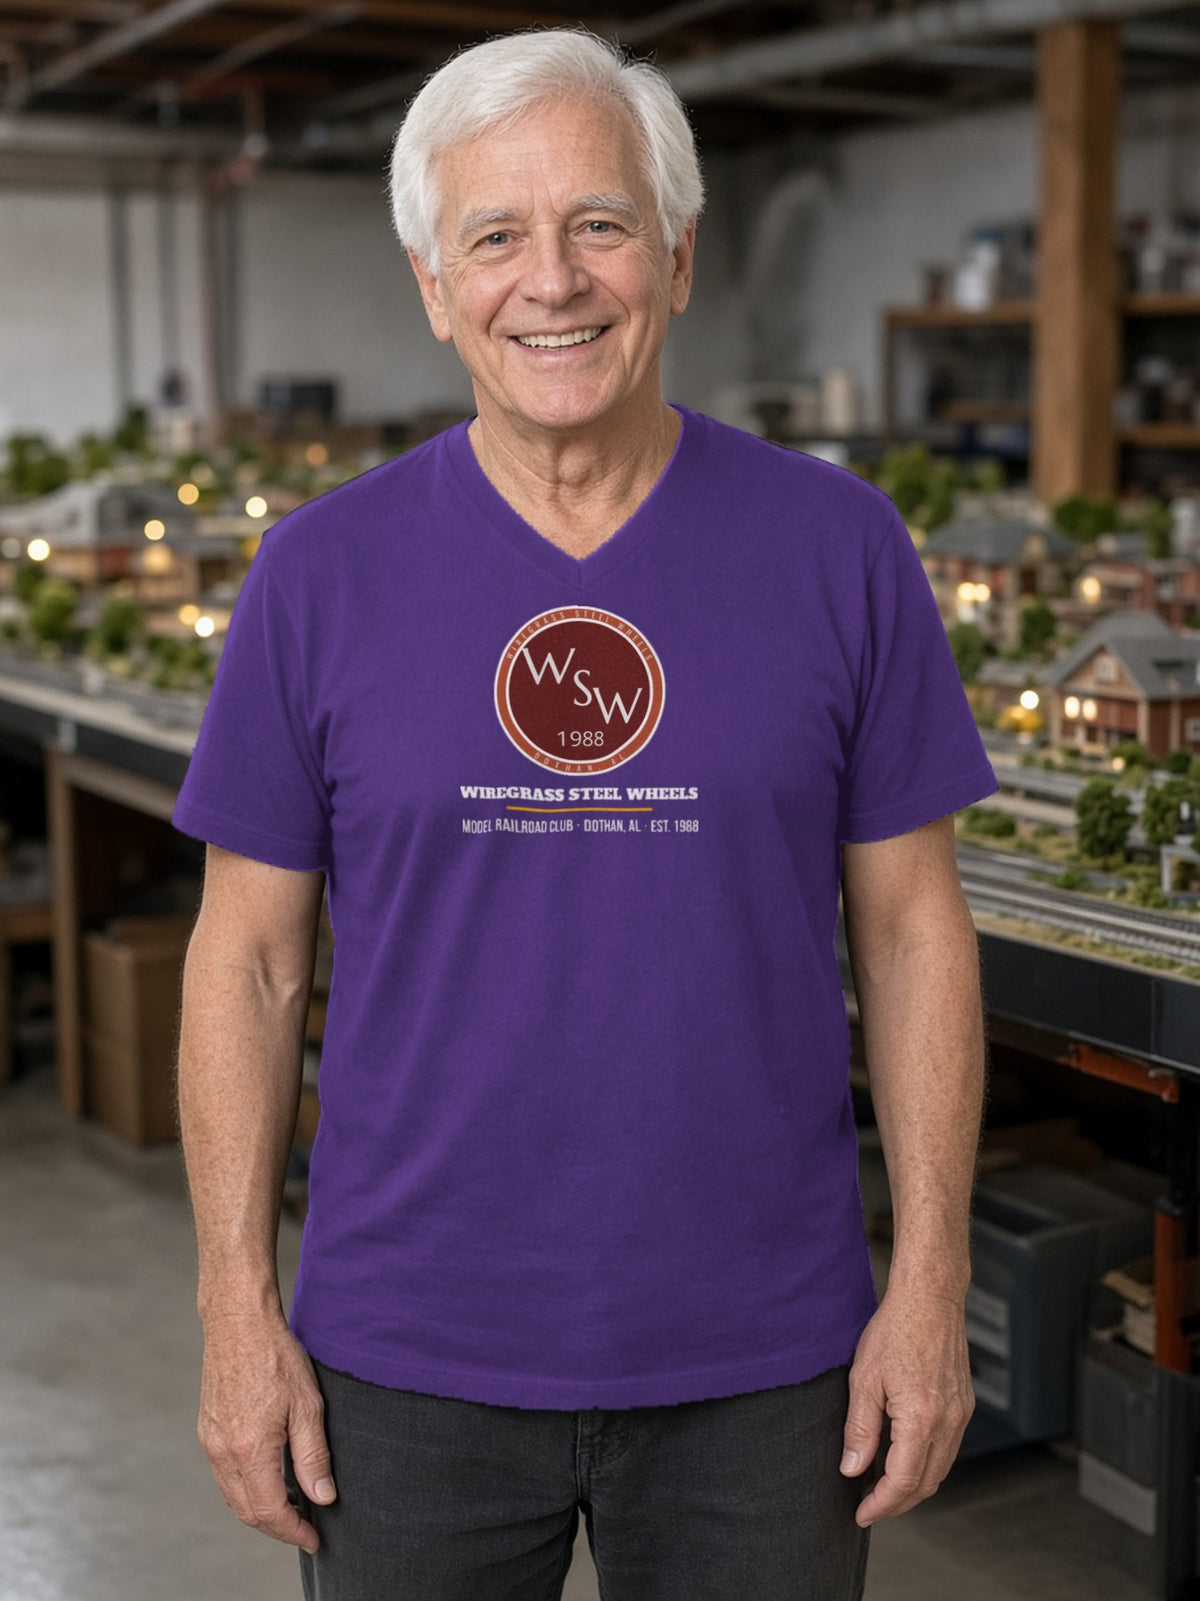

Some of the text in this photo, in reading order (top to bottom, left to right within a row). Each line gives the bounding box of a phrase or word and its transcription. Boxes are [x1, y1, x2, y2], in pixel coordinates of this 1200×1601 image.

[506, 609, 653, 661] WIREGRASS STEEL WHEELS
[557, 730, 604, 747] 1988
[611, 754, 625, 766] AL
[460, 786, 699, 802] WIREGRASS STEEL WHEELS
[462, 818, 699, 834] MODEL RAILROAD CLUB DOTHAN, AL EST. 1988
